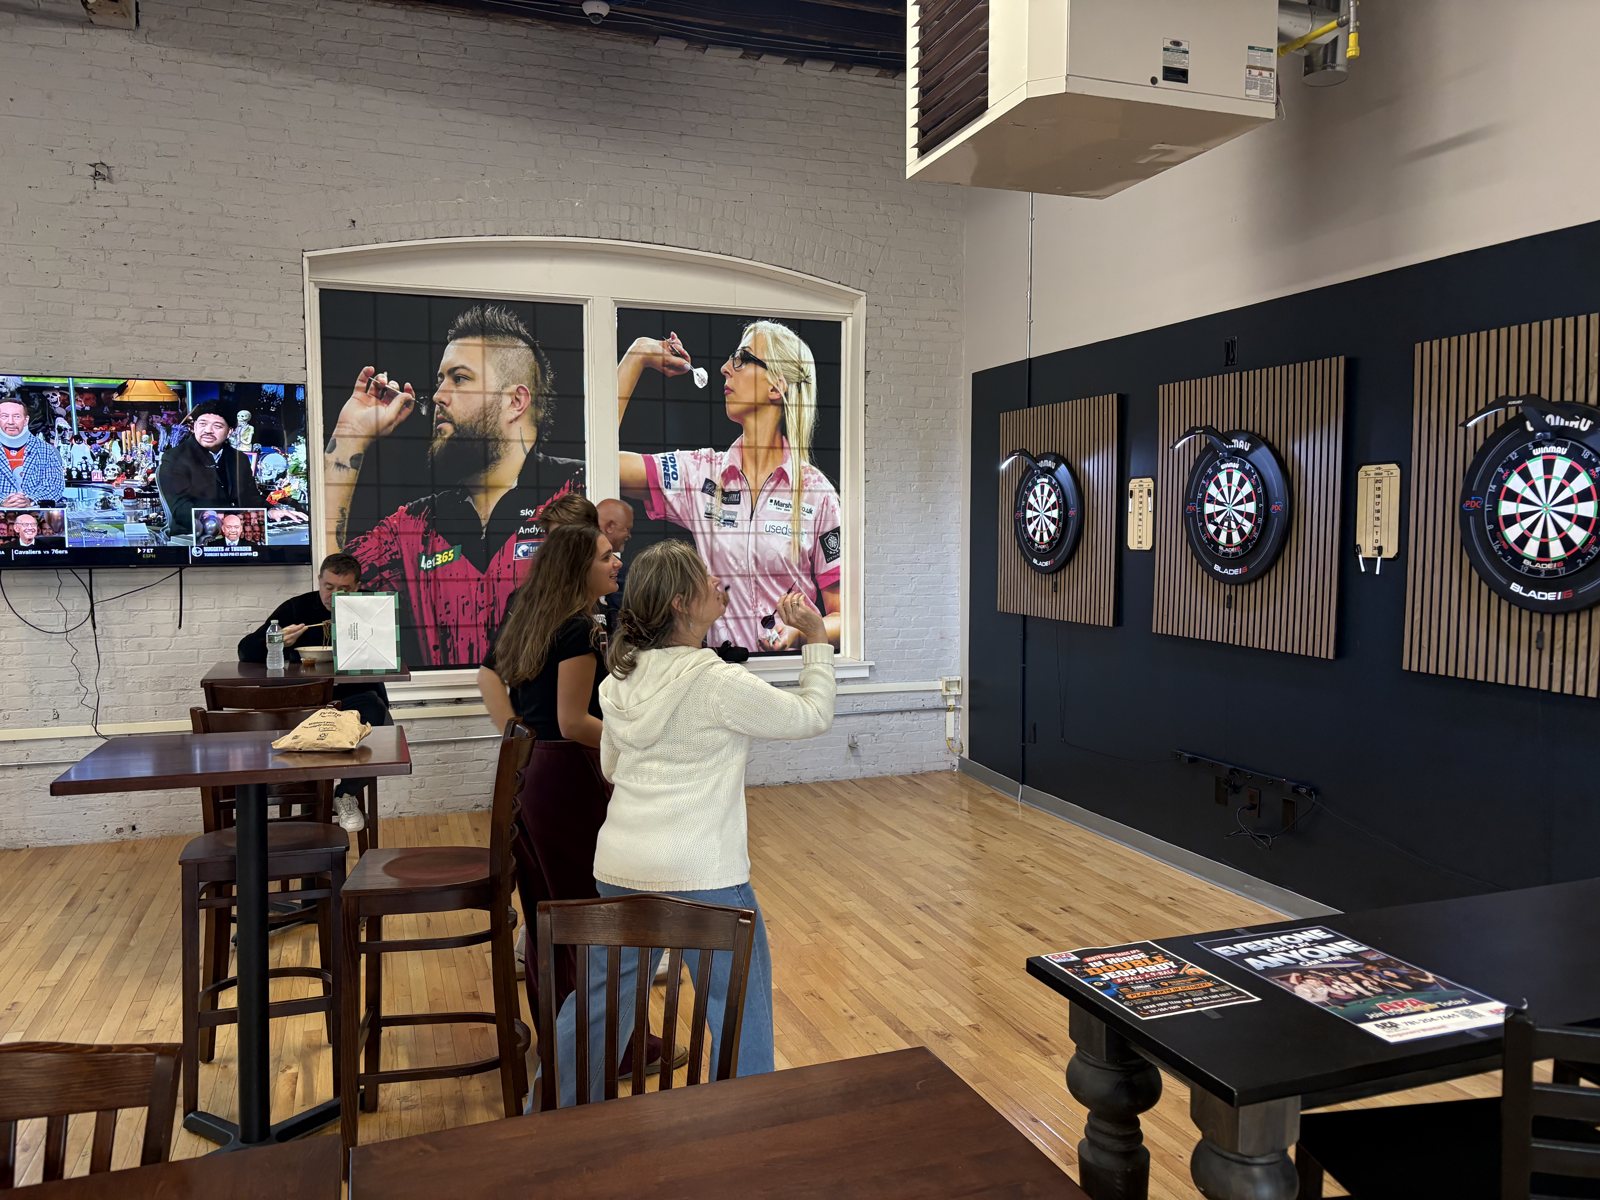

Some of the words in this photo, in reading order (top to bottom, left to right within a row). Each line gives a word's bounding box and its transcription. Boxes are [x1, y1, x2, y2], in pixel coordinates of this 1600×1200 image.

[661, 456, 672, 490] TIRES
[668, 453, 679, 481] TOYO
[520, 508, 536, 517] sky
[1212, 928, 1335, 957] EVERYONE
[1085, 954, 1170, 976] DOUBLE
[1088, 960, 1105, 968] IN
[1105, 952, 1150, 965] HOUSE
[1243, 939, 1369, 971] ANYONE
[1100, 961, 1178, 981] JEOPARDY
[1375, 997, 1427, 1014] APA
